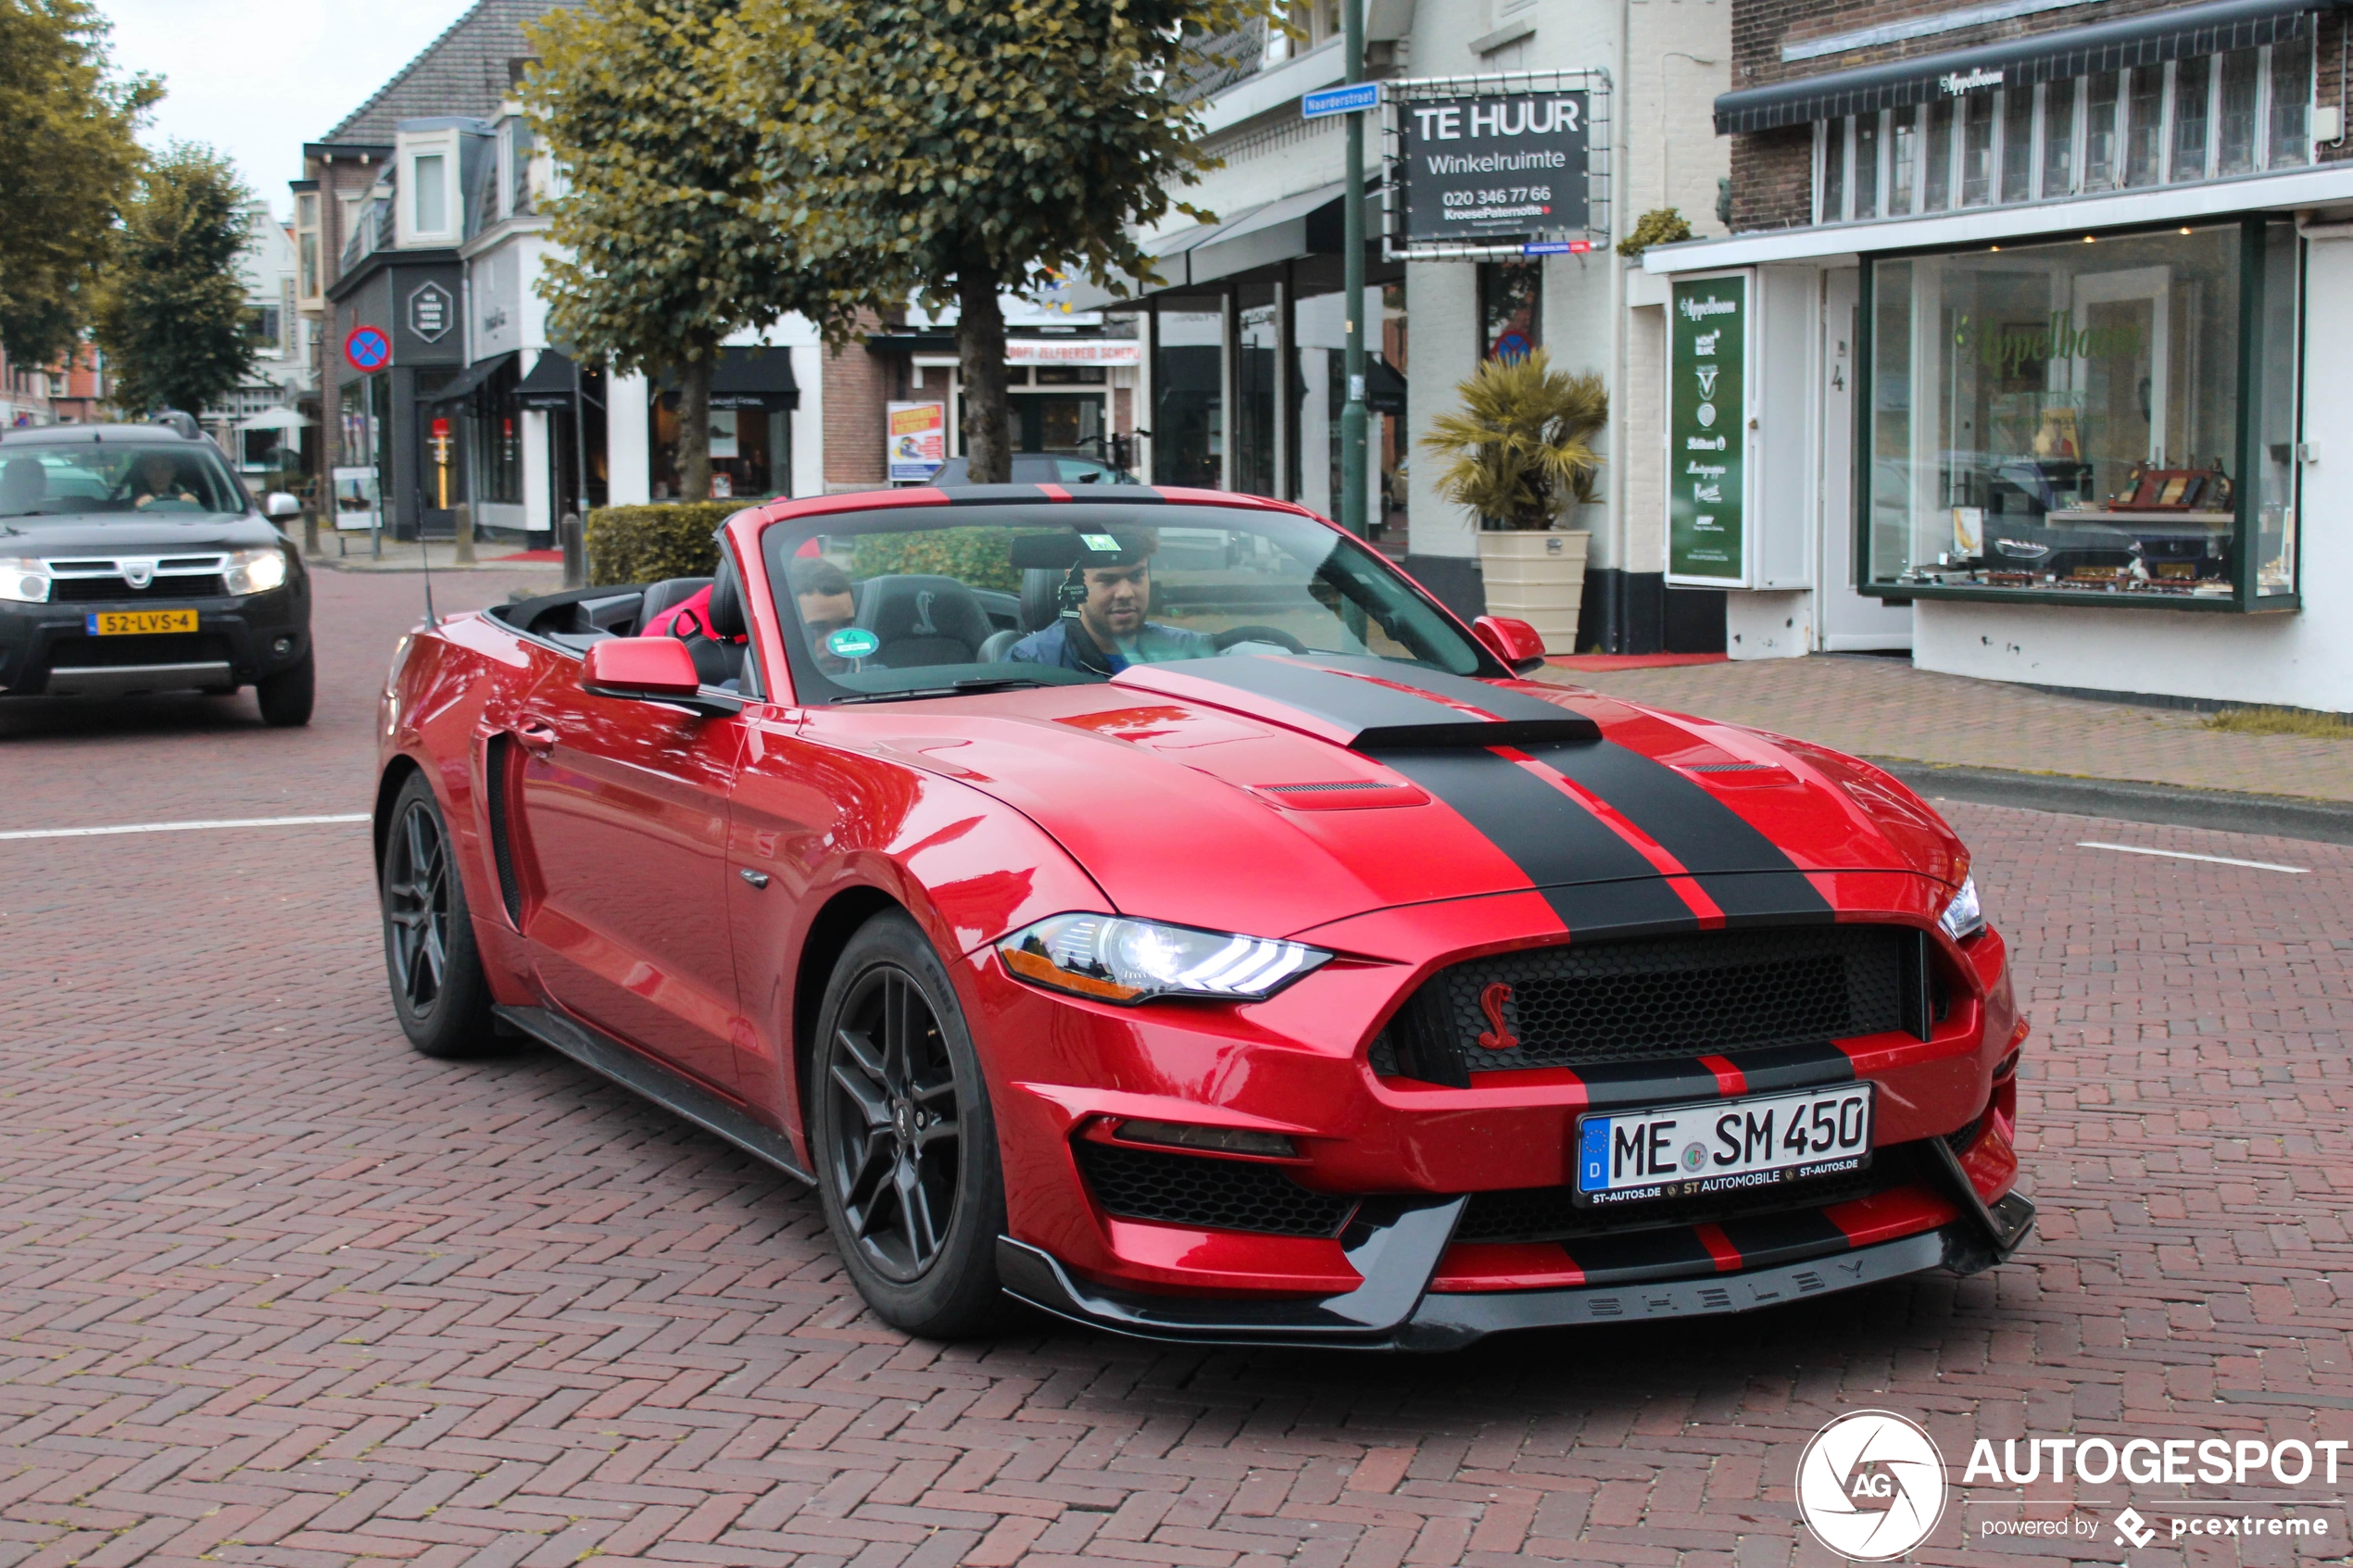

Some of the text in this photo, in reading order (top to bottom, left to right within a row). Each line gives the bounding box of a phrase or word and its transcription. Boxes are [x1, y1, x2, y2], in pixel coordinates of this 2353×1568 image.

[1940, 68, 2004, 96] Appelboom
[1307, 90, 1374, 111] Naarderstraat
[1414, 99, 1579, 141] TE HUUR
[1427, 149, 1567, 175] Winkelruimte
[1442, 191, 1474, 207] 020
[1478, 188, 1506, 204] 346
[1444, 205, 1543, 220] KroesePaternotte
[1680, 295, 1736, 321] Appelboom
[1695, 334, 1716, 346] MONT
[1695, 346, 1716, 356] BLANC
[1955, 309, 2142, 379] Appelboom
[1831, 365, 1844, 392] 4
[106, 614, 190, 632] 52-LVS-4
[845, 632, 858, 643] 4
[1614, 1097, 1864, 1179] ME SM 450
[1590, 1162, 1601, 1179] D
[1592, 1160, 1859, 1204] ST-AUTOS.DE ST AUTOMOBILE ST-AUTOS.DE
[1587, 1260, 1864, 1316] SHELBY
